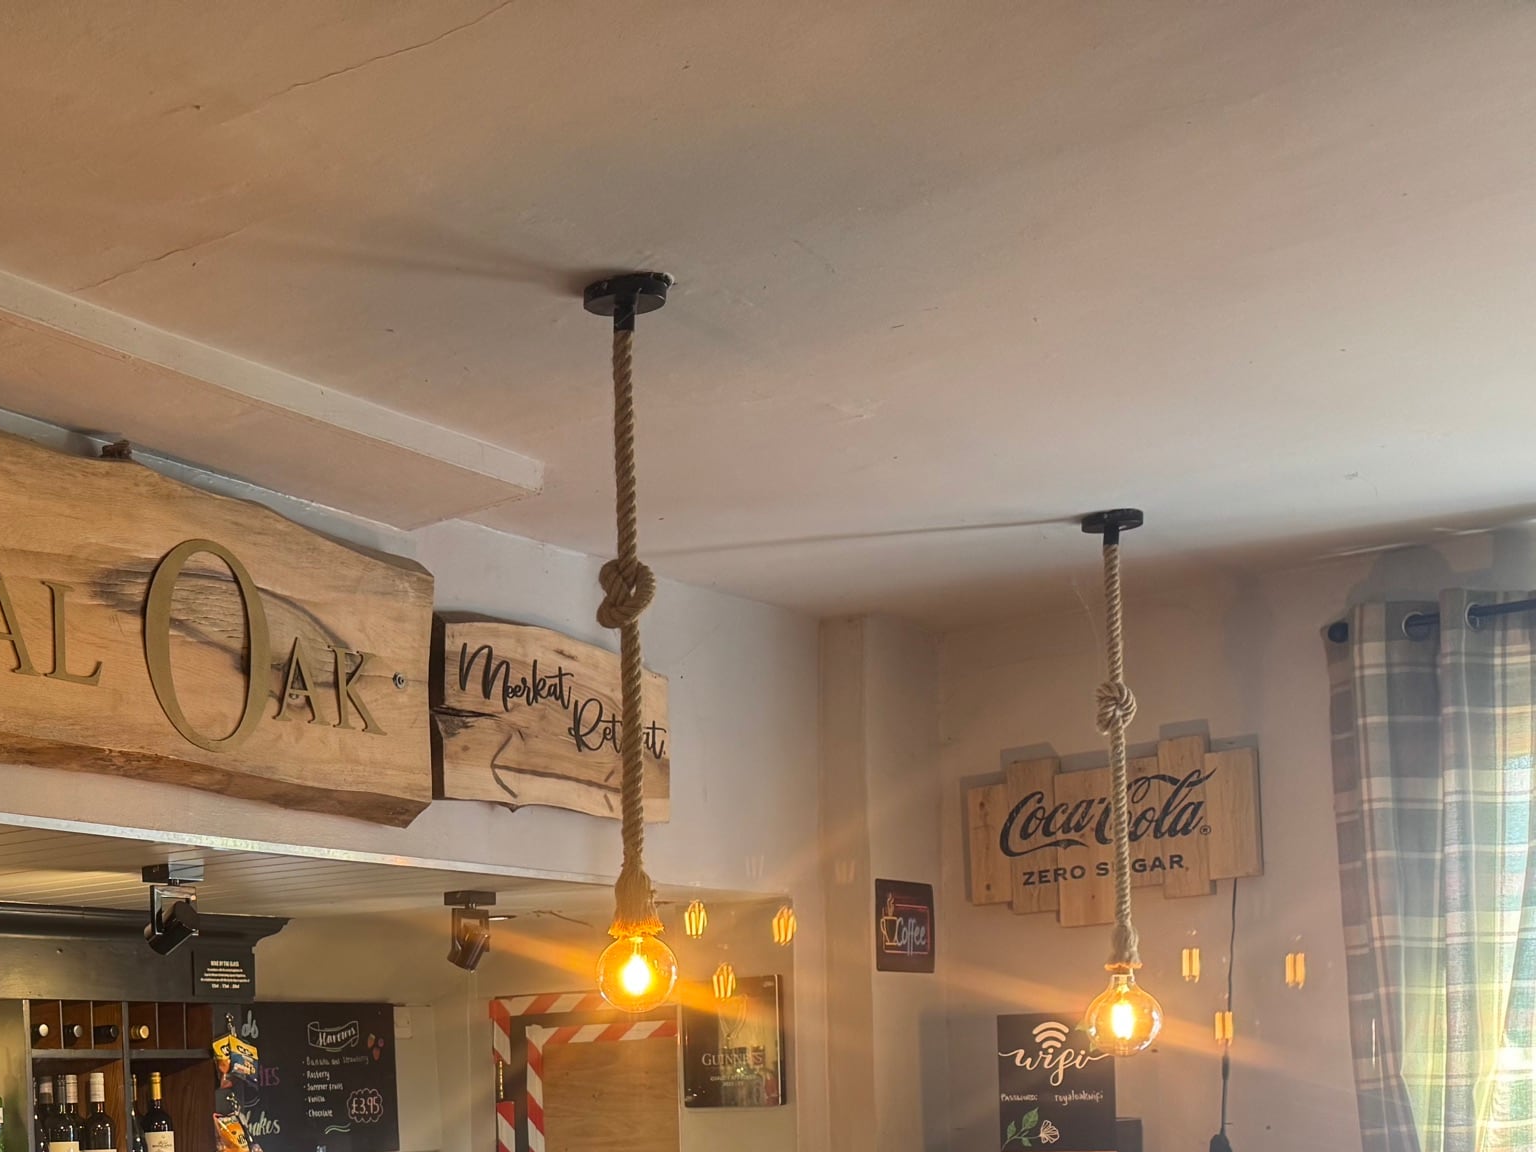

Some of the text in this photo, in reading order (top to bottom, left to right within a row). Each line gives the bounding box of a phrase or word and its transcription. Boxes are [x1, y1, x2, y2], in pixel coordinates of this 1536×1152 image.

[144, 538, 387, 751] OAK
[459, 642, 575, 712] Meerkat
[568, 698, 667, 760] Retat
[1022, 853, 1185, 887] ZERO SGAR
[895, 916, 928, 957] Coffee
[998, 1047, 1112, 1087] wifi
[351, 1096, 380, 1115] £3.95
